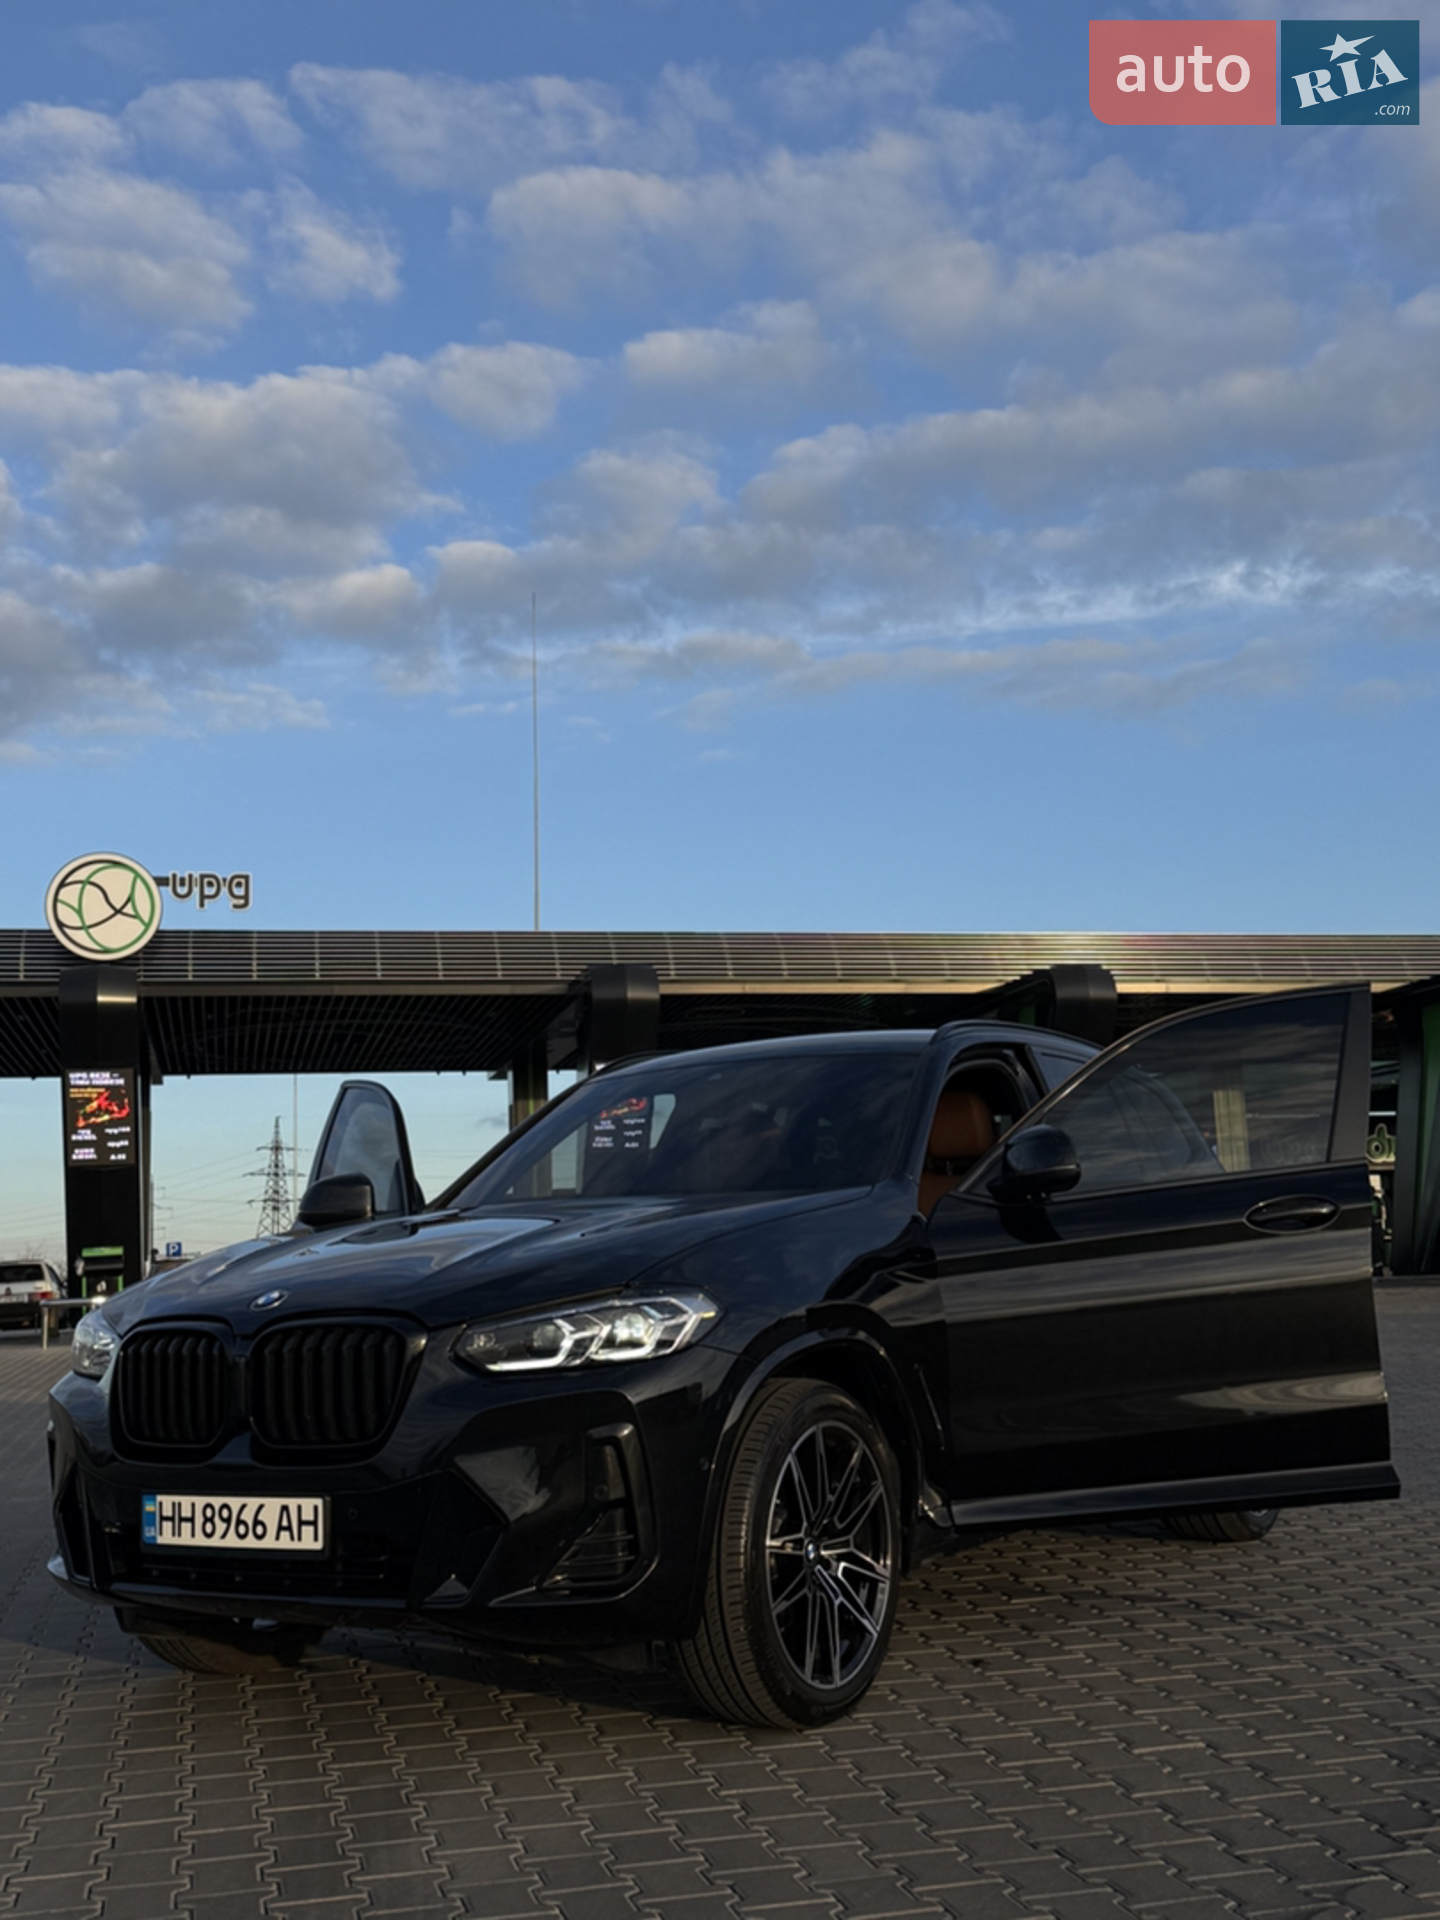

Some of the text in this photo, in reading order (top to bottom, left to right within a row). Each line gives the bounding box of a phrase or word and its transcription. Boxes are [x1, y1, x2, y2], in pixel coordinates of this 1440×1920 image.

[170, 872, 251, 910] upg
[169, 1243, 179, 1257] P
[274, 1504, 319, 1543] AH
